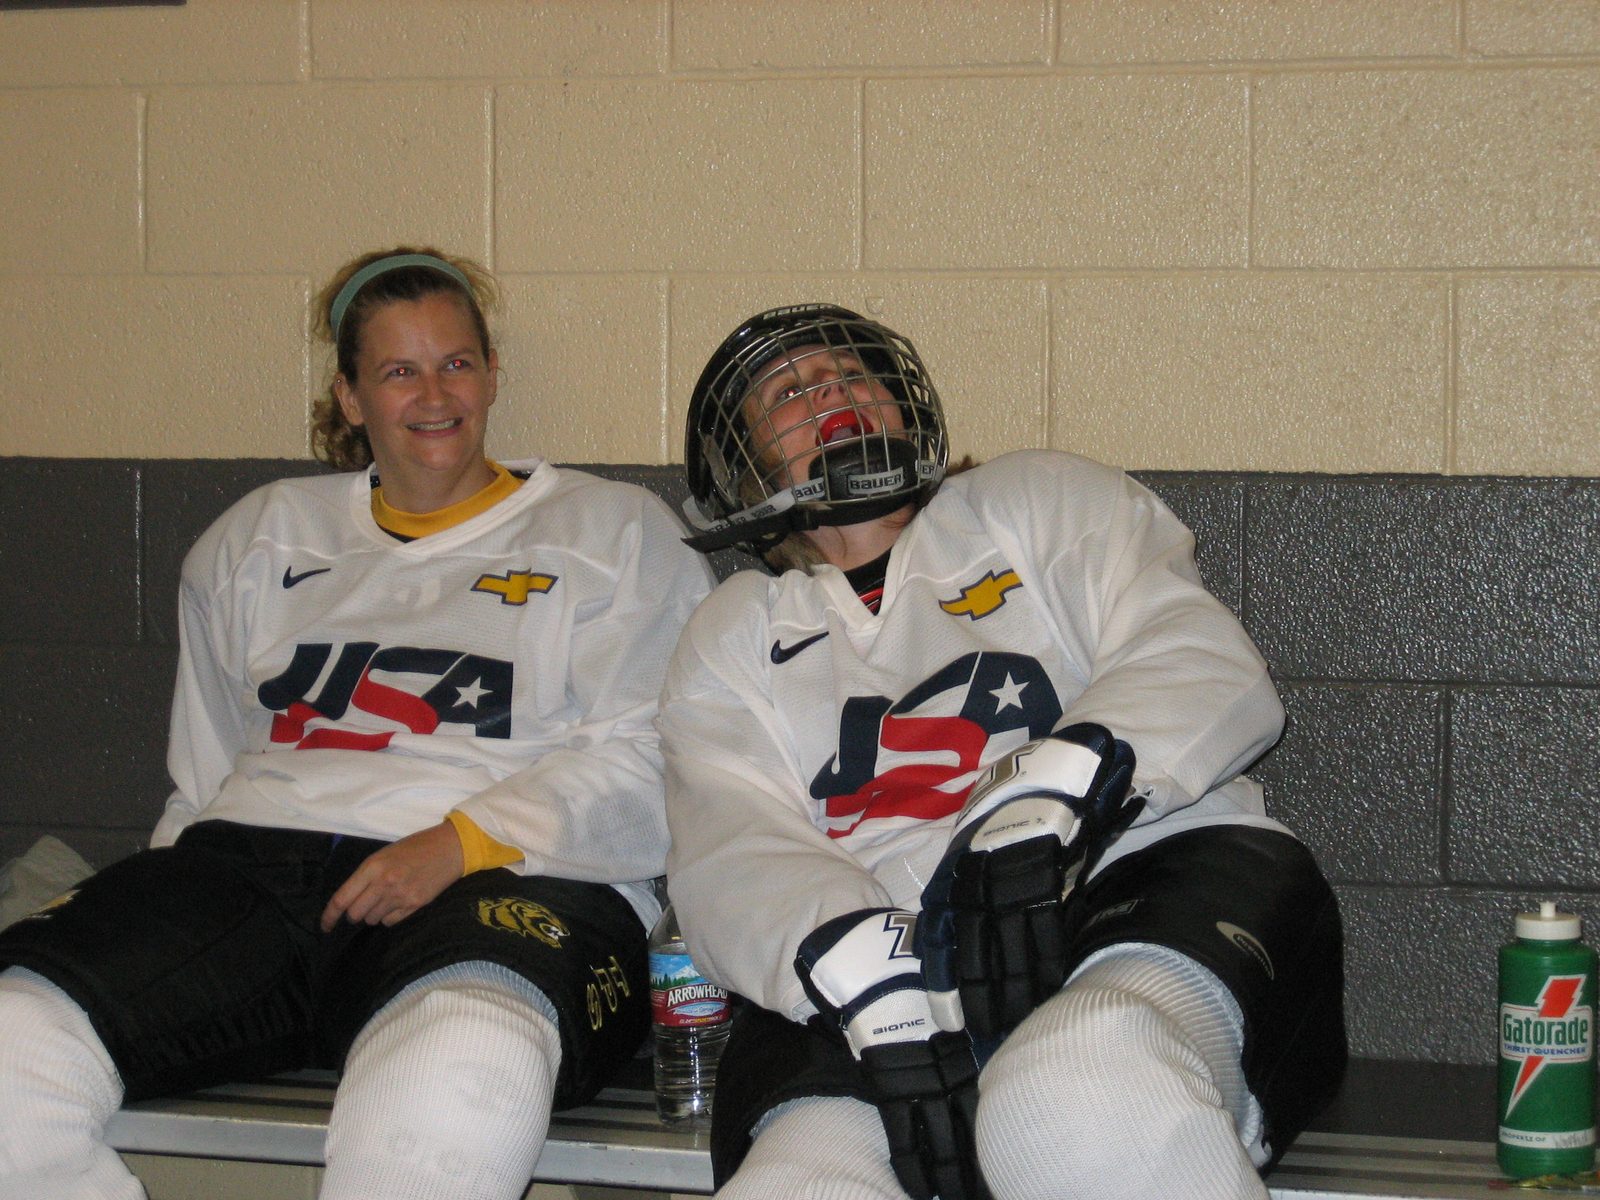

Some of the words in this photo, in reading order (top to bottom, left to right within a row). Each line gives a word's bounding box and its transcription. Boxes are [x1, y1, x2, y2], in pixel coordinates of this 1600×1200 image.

[849, 473, 904, 490] BAUER
[257, 641, 514, 746] USA
[809, 650, 1064, 812] USA
[666, 984, 728, 1008] ARROWHEAD
[1503, 1013, 1588, 1046] Gatorade
[1503, 1043, 1531, 1054] THIRST
[1533, 1046, 1586, 1056] QUENCHER
